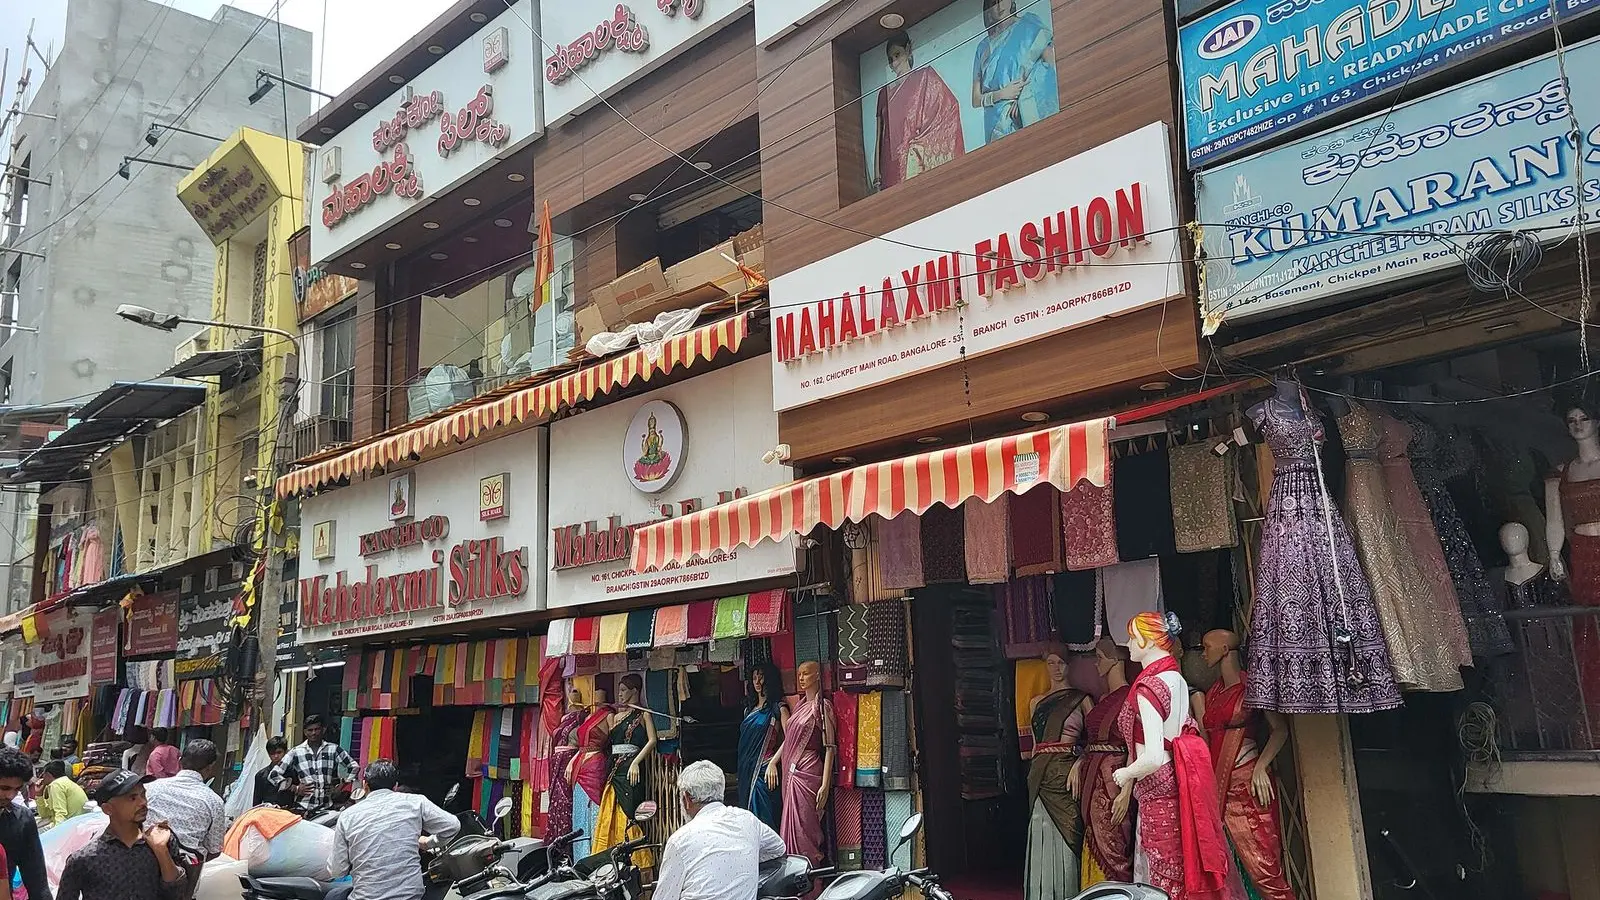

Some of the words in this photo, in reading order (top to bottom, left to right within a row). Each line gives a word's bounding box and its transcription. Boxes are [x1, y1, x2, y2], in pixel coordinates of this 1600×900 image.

[1207, 92, 1293, 134] Exclusive
[1300, 83, 1320, 97] in
[1342, 7, 1490, 80] READYMADE
[1209, 21, 1245, 51] JAI
[1302, 103, 1316, 115] #
[1321, 88, 1357, 107] 163,
[1362, 54, 1440, 90] Chickpet
[1446, 33, 1494, 58] Main
[1500, 7, 1559, 36] Road,
[1191, 143, 1214, 160] GSTIN:
[1225, 202, 1293, 232] KANCHI-CO
[1292, 207, 1492, 277] KANCHEEPURAM
[1498, 186, 1576, 224] SILKS
[776, 251, 963, 364] MAHALAXMI
[975, 182, 1147, 297] FASHION
[1264, 278, 1324, 300] Basement,
[1328, 263, 1382, 285] Chickpet
[1385, 255, 1418, 271] Main
[800, 379, 812, 389] NO.
[826, 365, 858, 381] CHICKPET
[859, 360, 876, 373] MAIN
[877, 354, 899, 368] ROAD,
[901, 339, 947, 360] BANGALORE
[973, 319, 1008, 338] BRANCH
[1013, 309, 1039, 325] GSTIN
[1046, 280, 1132, 315] 29AORPK7866B1ZD
[358, 522, 418, 557] KANCHI
[420, 515, 447, 542] CO
[552, 502, 673, 571] Mahala
[299, 550, 444, 628] Mahalaxmi
[448, 537, 527, 607] Silks
[611, 568, 640, 580] CHICKPE
